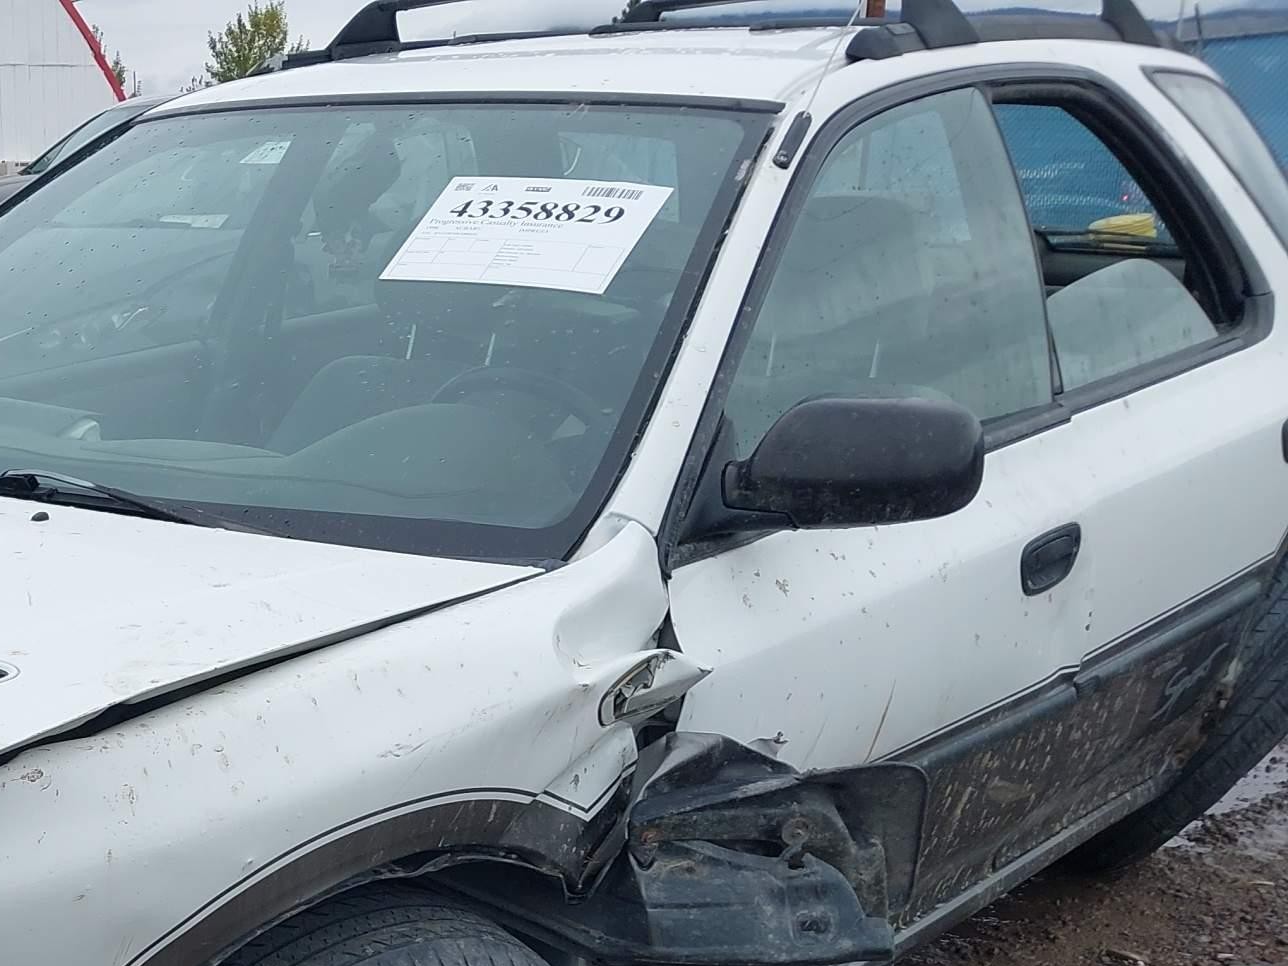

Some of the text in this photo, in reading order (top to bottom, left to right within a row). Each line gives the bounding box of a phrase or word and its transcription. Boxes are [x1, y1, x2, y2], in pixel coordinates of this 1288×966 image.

[450, 199, 625, 225] 43358829
[480, 219, 518, 227] Casualty
[520, 220, 563, 229] Insurance
